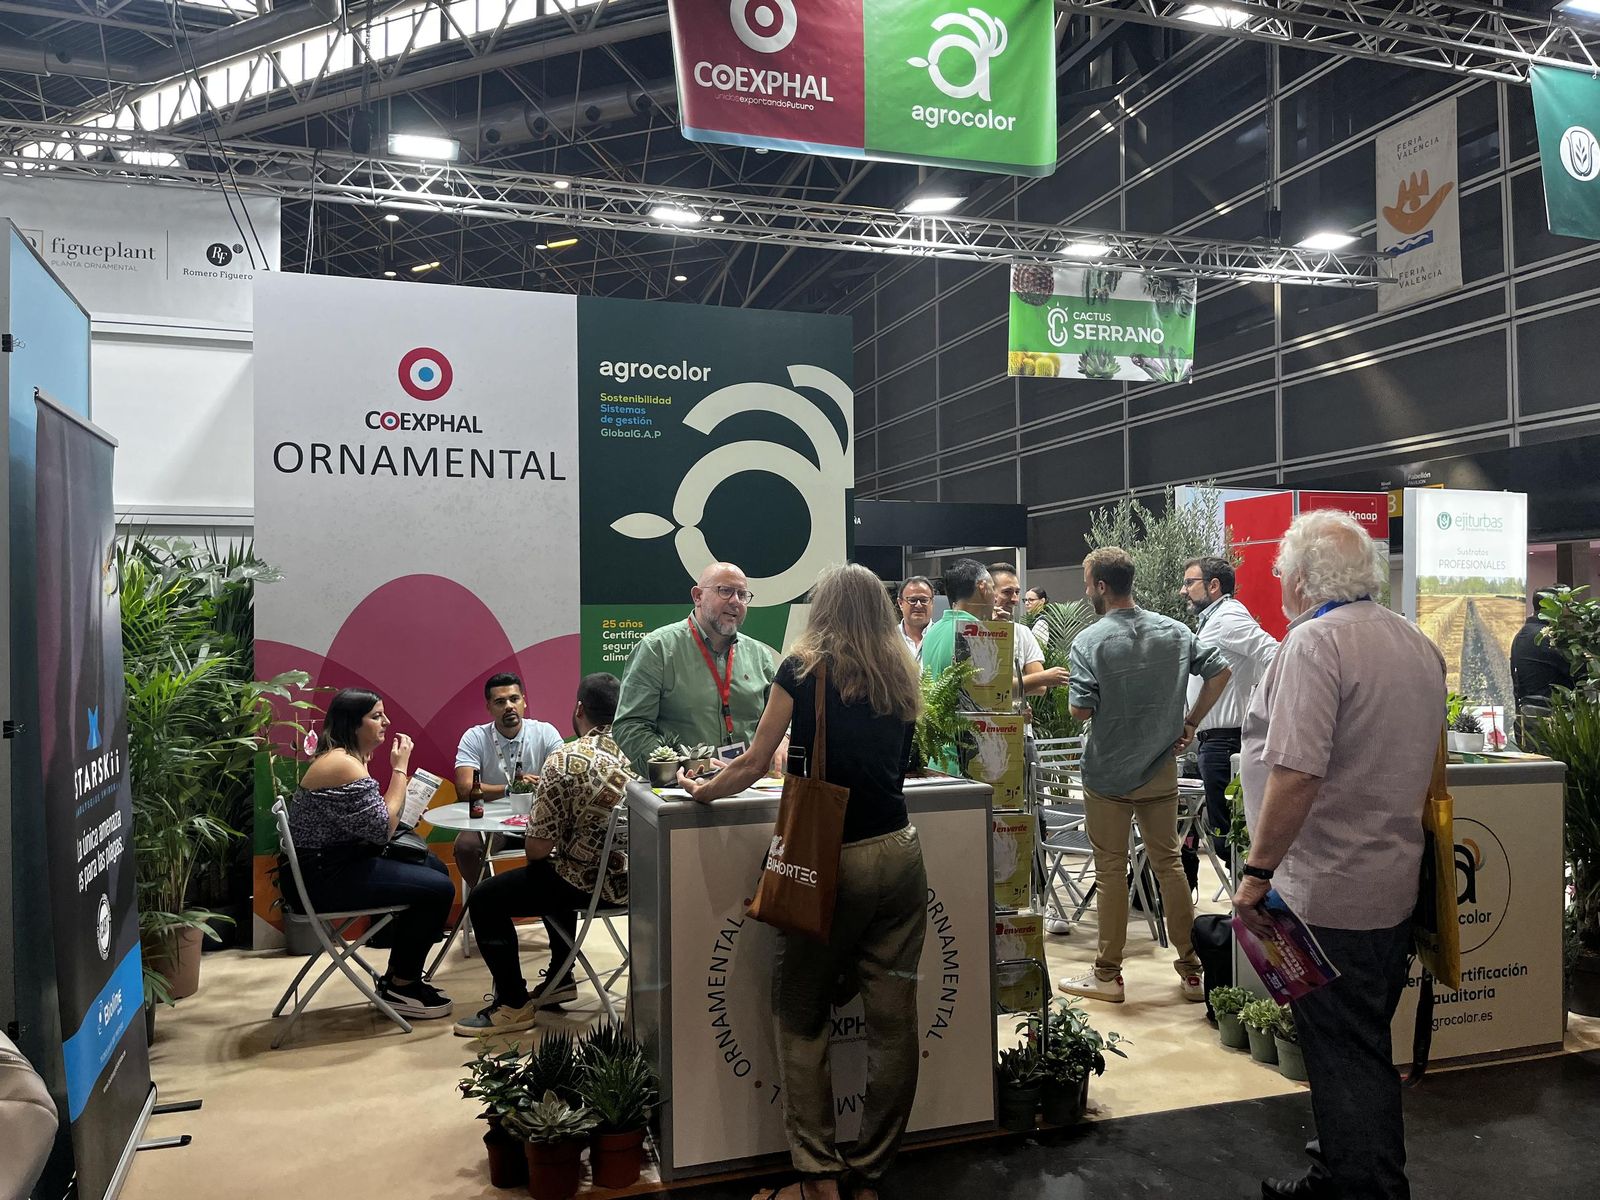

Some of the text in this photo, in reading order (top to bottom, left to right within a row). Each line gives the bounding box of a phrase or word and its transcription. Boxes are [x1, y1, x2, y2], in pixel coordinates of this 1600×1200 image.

[693, 61, 834, 102] COEXPHAL
[911, 104, 1017, 131] agrocolor
[1396, 135, 1423, 152] FERIA
[1397, 136, 1440, 160] VALENCIA
[51, 236, 157, 262] figueplant
[51, 259, 138, 272] PLANTA ORNAMENTAL
[182, 267, 254, 281] Romero Figuero
[1398, 266, 1426, 280] FERIA
[1399, 269, 1443, 288] VALENCIA
[1073, 311, 1112, 322] CACTUS
[1073, 323, 1165, 344] SERRANO
[599, 360, 712, 383] agrocolor
[600, 392, 672, 405] Sostenibilidad
[600, 404, 646, 415] Sistemas
[365, 410, 483, 433] COEXPHAL
[600, 414, 653, 427] de gestión
[600, 428, 662, 439] GlobalG.A.P
[273, 441, 566, 481] ORNAMENTAL
[1455, 512, 1503, 529] ejiturbas
[1457, 547, 1489, 557] Sustratos
[1438, 559, 1506, 570] PROFESIONALES
[602, 619, 644, 628] 25 años
[602, 653, 629, 662] alime
[83, 825, 99, 856] única
[98, 809, 122, 844] amenaza
[78, 869, 85, 894] es
[84, 856, 98, 892] para
[97, 849, 106, 875] las
[766, 856, 818, 884] BIHORTEC
[1458, 909, 1493, 925] color
[1461, 963, 1528, 982] rtificación
[707, 915, 752, 1078] ORNAMENTAL
[1431, 1011, 1494, 1032] grocolor.es
